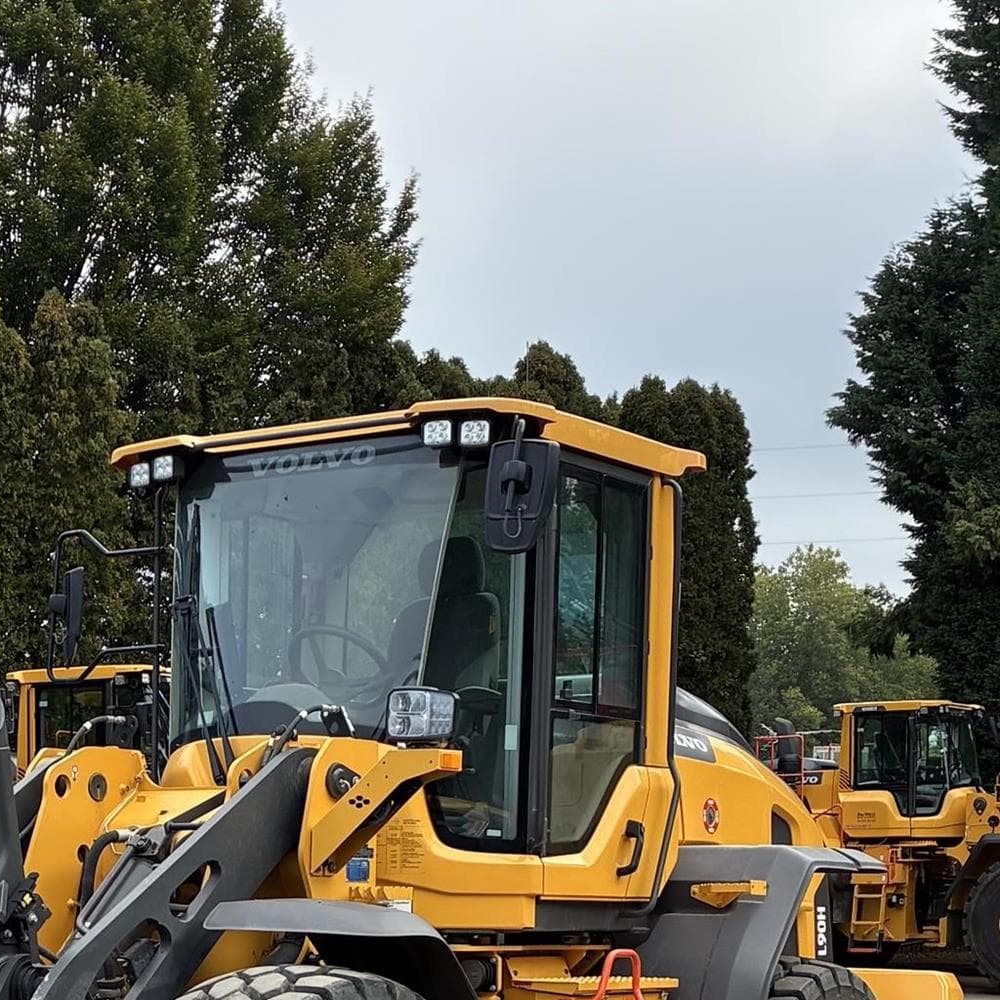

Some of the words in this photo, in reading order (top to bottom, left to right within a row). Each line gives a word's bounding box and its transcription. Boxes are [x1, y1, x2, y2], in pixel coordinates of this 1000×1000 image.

[247, 445, 376, 477] VOLVO
[674, 733, 708, 752] LVO
[816, 906, 827, 956] L90H
